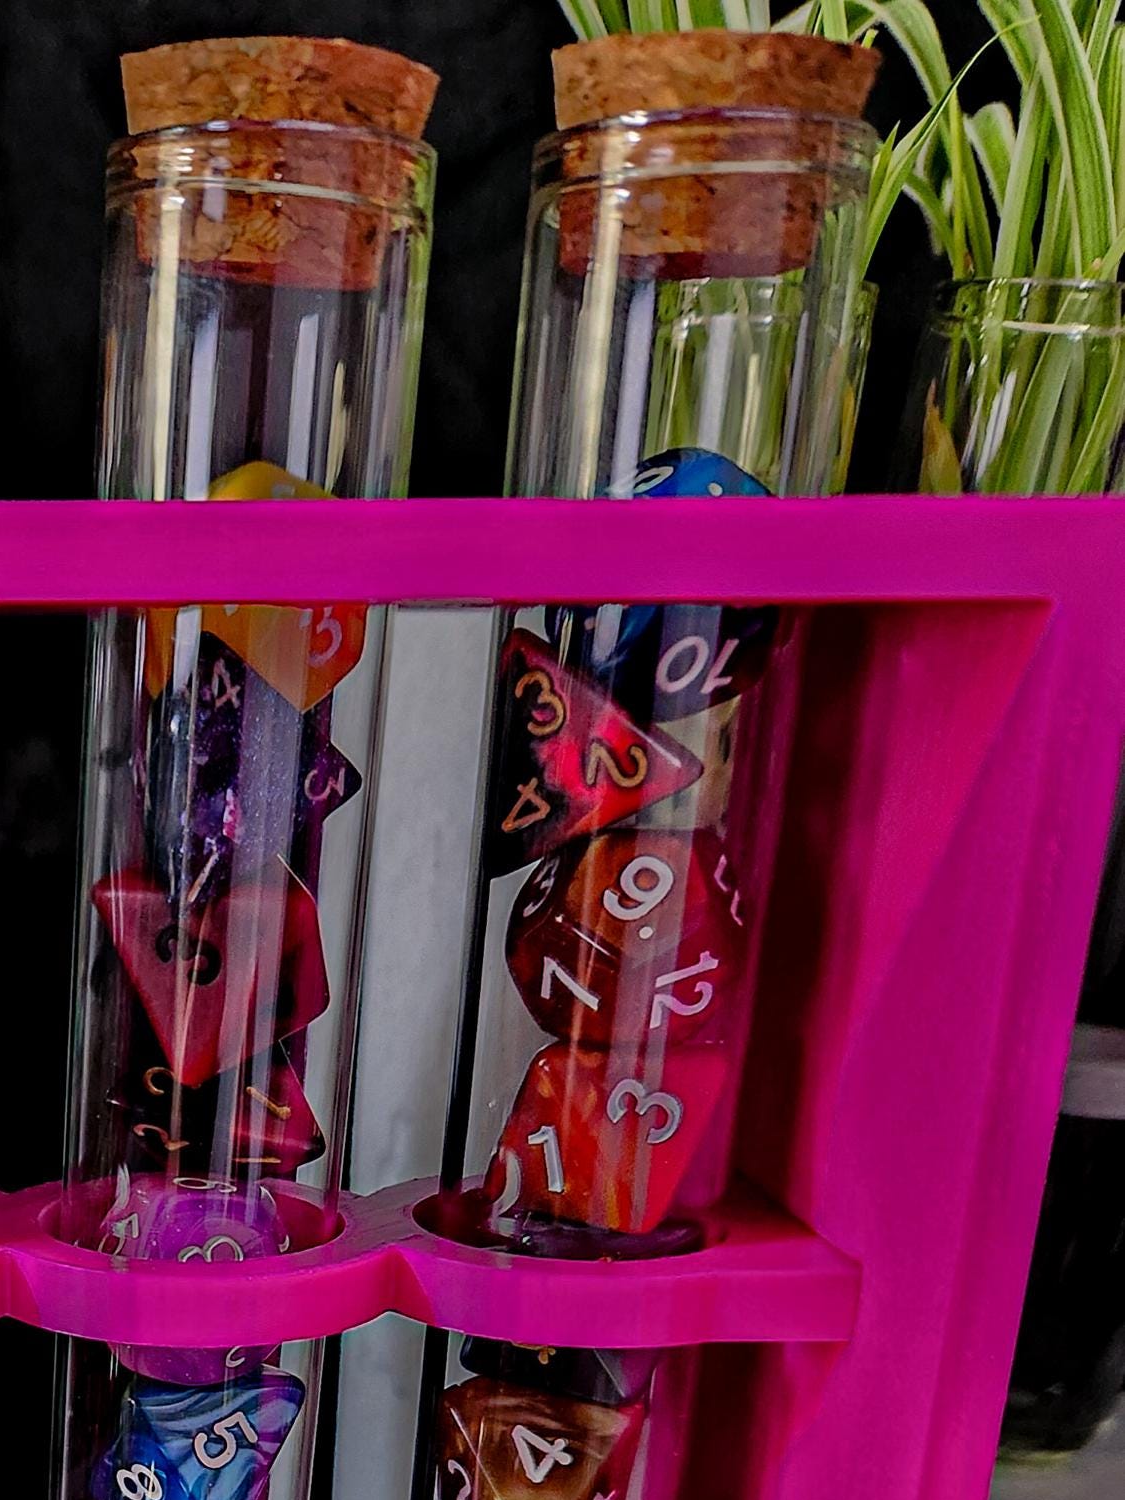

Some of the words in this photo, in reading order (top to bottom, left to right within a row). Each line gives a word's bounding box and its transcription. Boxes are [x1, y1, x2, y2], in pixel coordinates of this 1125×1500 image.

[514, 669, 565, 737] 3
[585, 744, 648, 788] 2
[501, 777, 551, 833] 4
[607, 1078, 683, 1144] 3
[527, 1125, 565, 1193] 1
[193, 1411, 259, 1470] 5
[511, 1424, 574, 1485] 4
